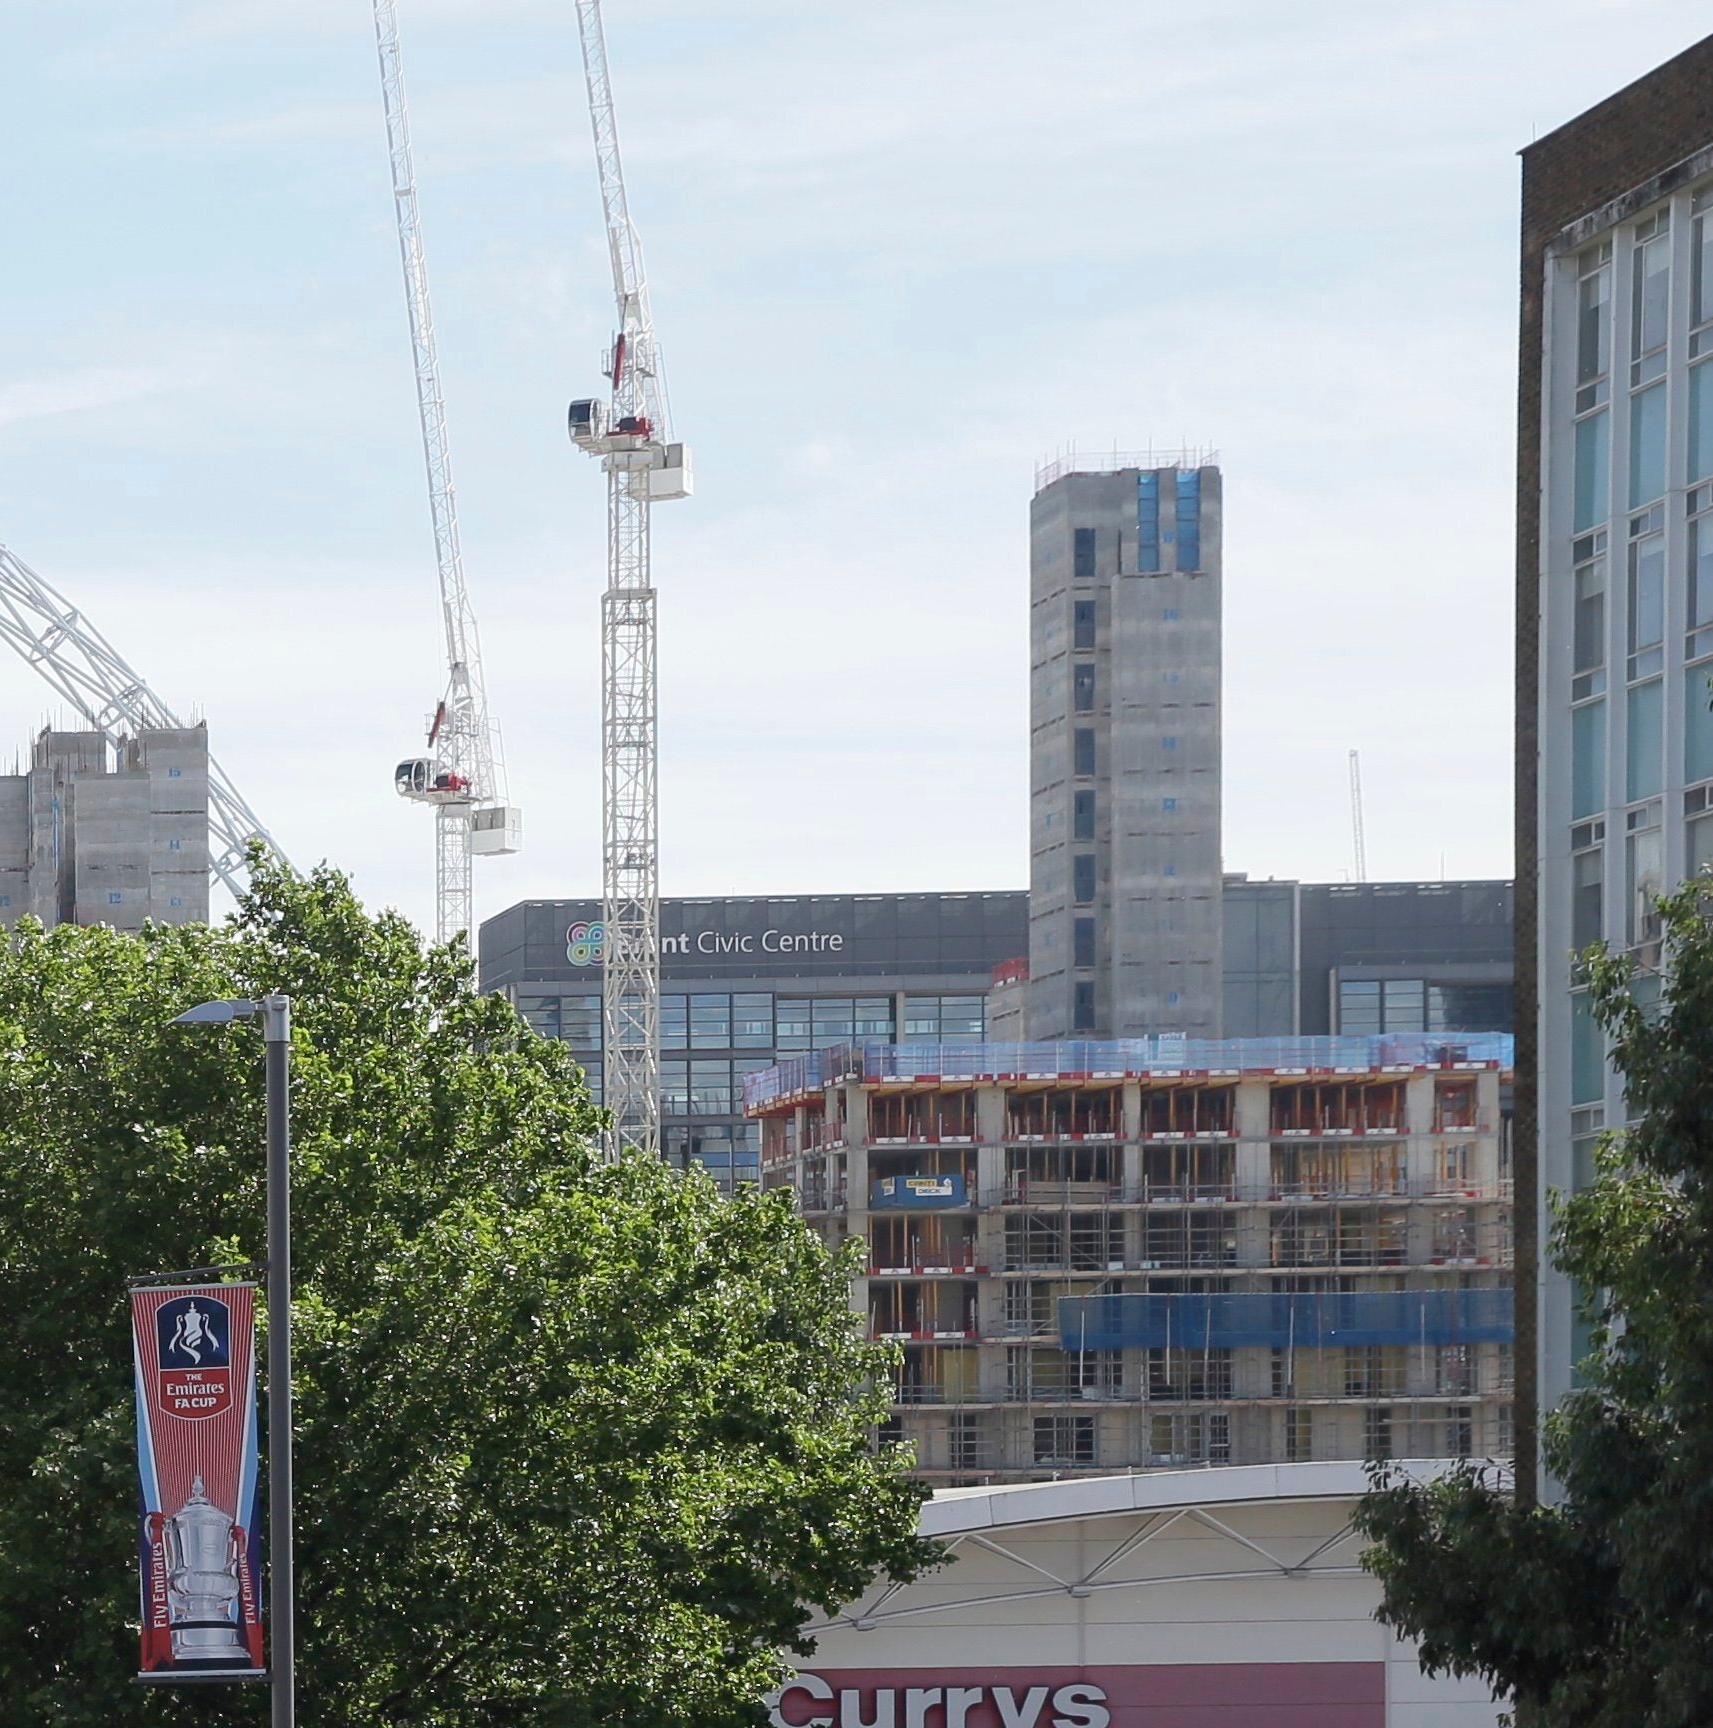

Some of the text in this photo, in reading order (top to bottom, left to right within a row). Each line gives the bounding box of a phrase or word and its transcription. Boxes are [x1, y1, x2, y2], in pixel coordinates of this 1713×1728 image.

[696, 930, 753, 953] Civic
[761, 928, 843, 952] Centre
[185, 1373, 202, 1381] THE
[166, 1382, 224, 1396] Emirates
[175, 1396, 217, 1408] FA CUP
[153, 1541, 168, 1628] Fly Emirates
[238, 1552, 255, 1625] Fly Emirates
